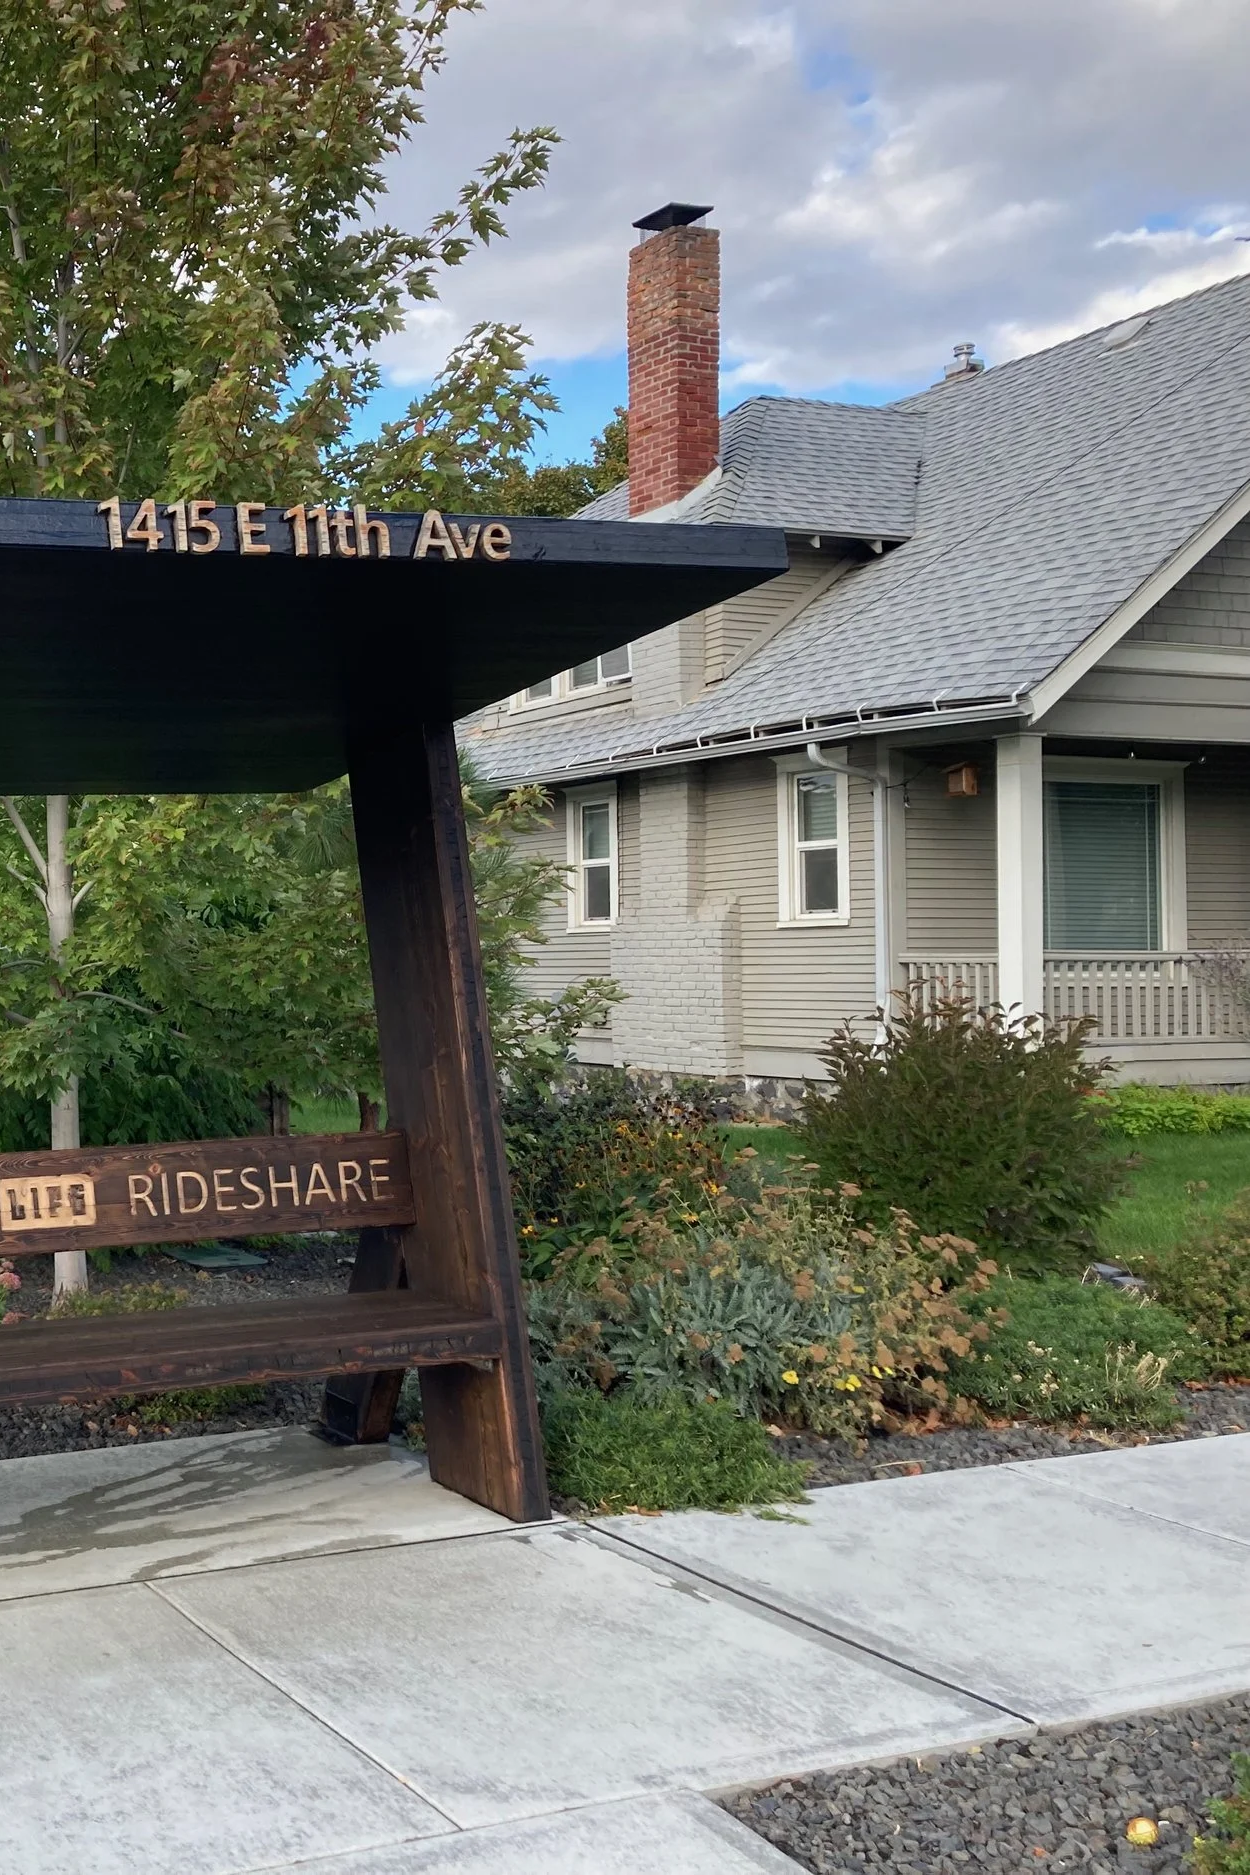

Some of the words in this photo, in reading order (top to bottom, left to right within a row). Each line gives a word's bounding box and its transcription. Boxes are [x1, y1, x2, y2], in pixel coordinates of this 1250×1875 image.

[97, 496, 221, 553] 1415
[236, 502, 271, 556] E
[282, 503, 390, 559] 11th
[413, 509, 511, 562] Ave
[128, 1159, 394, 1217] RIDESHARE
